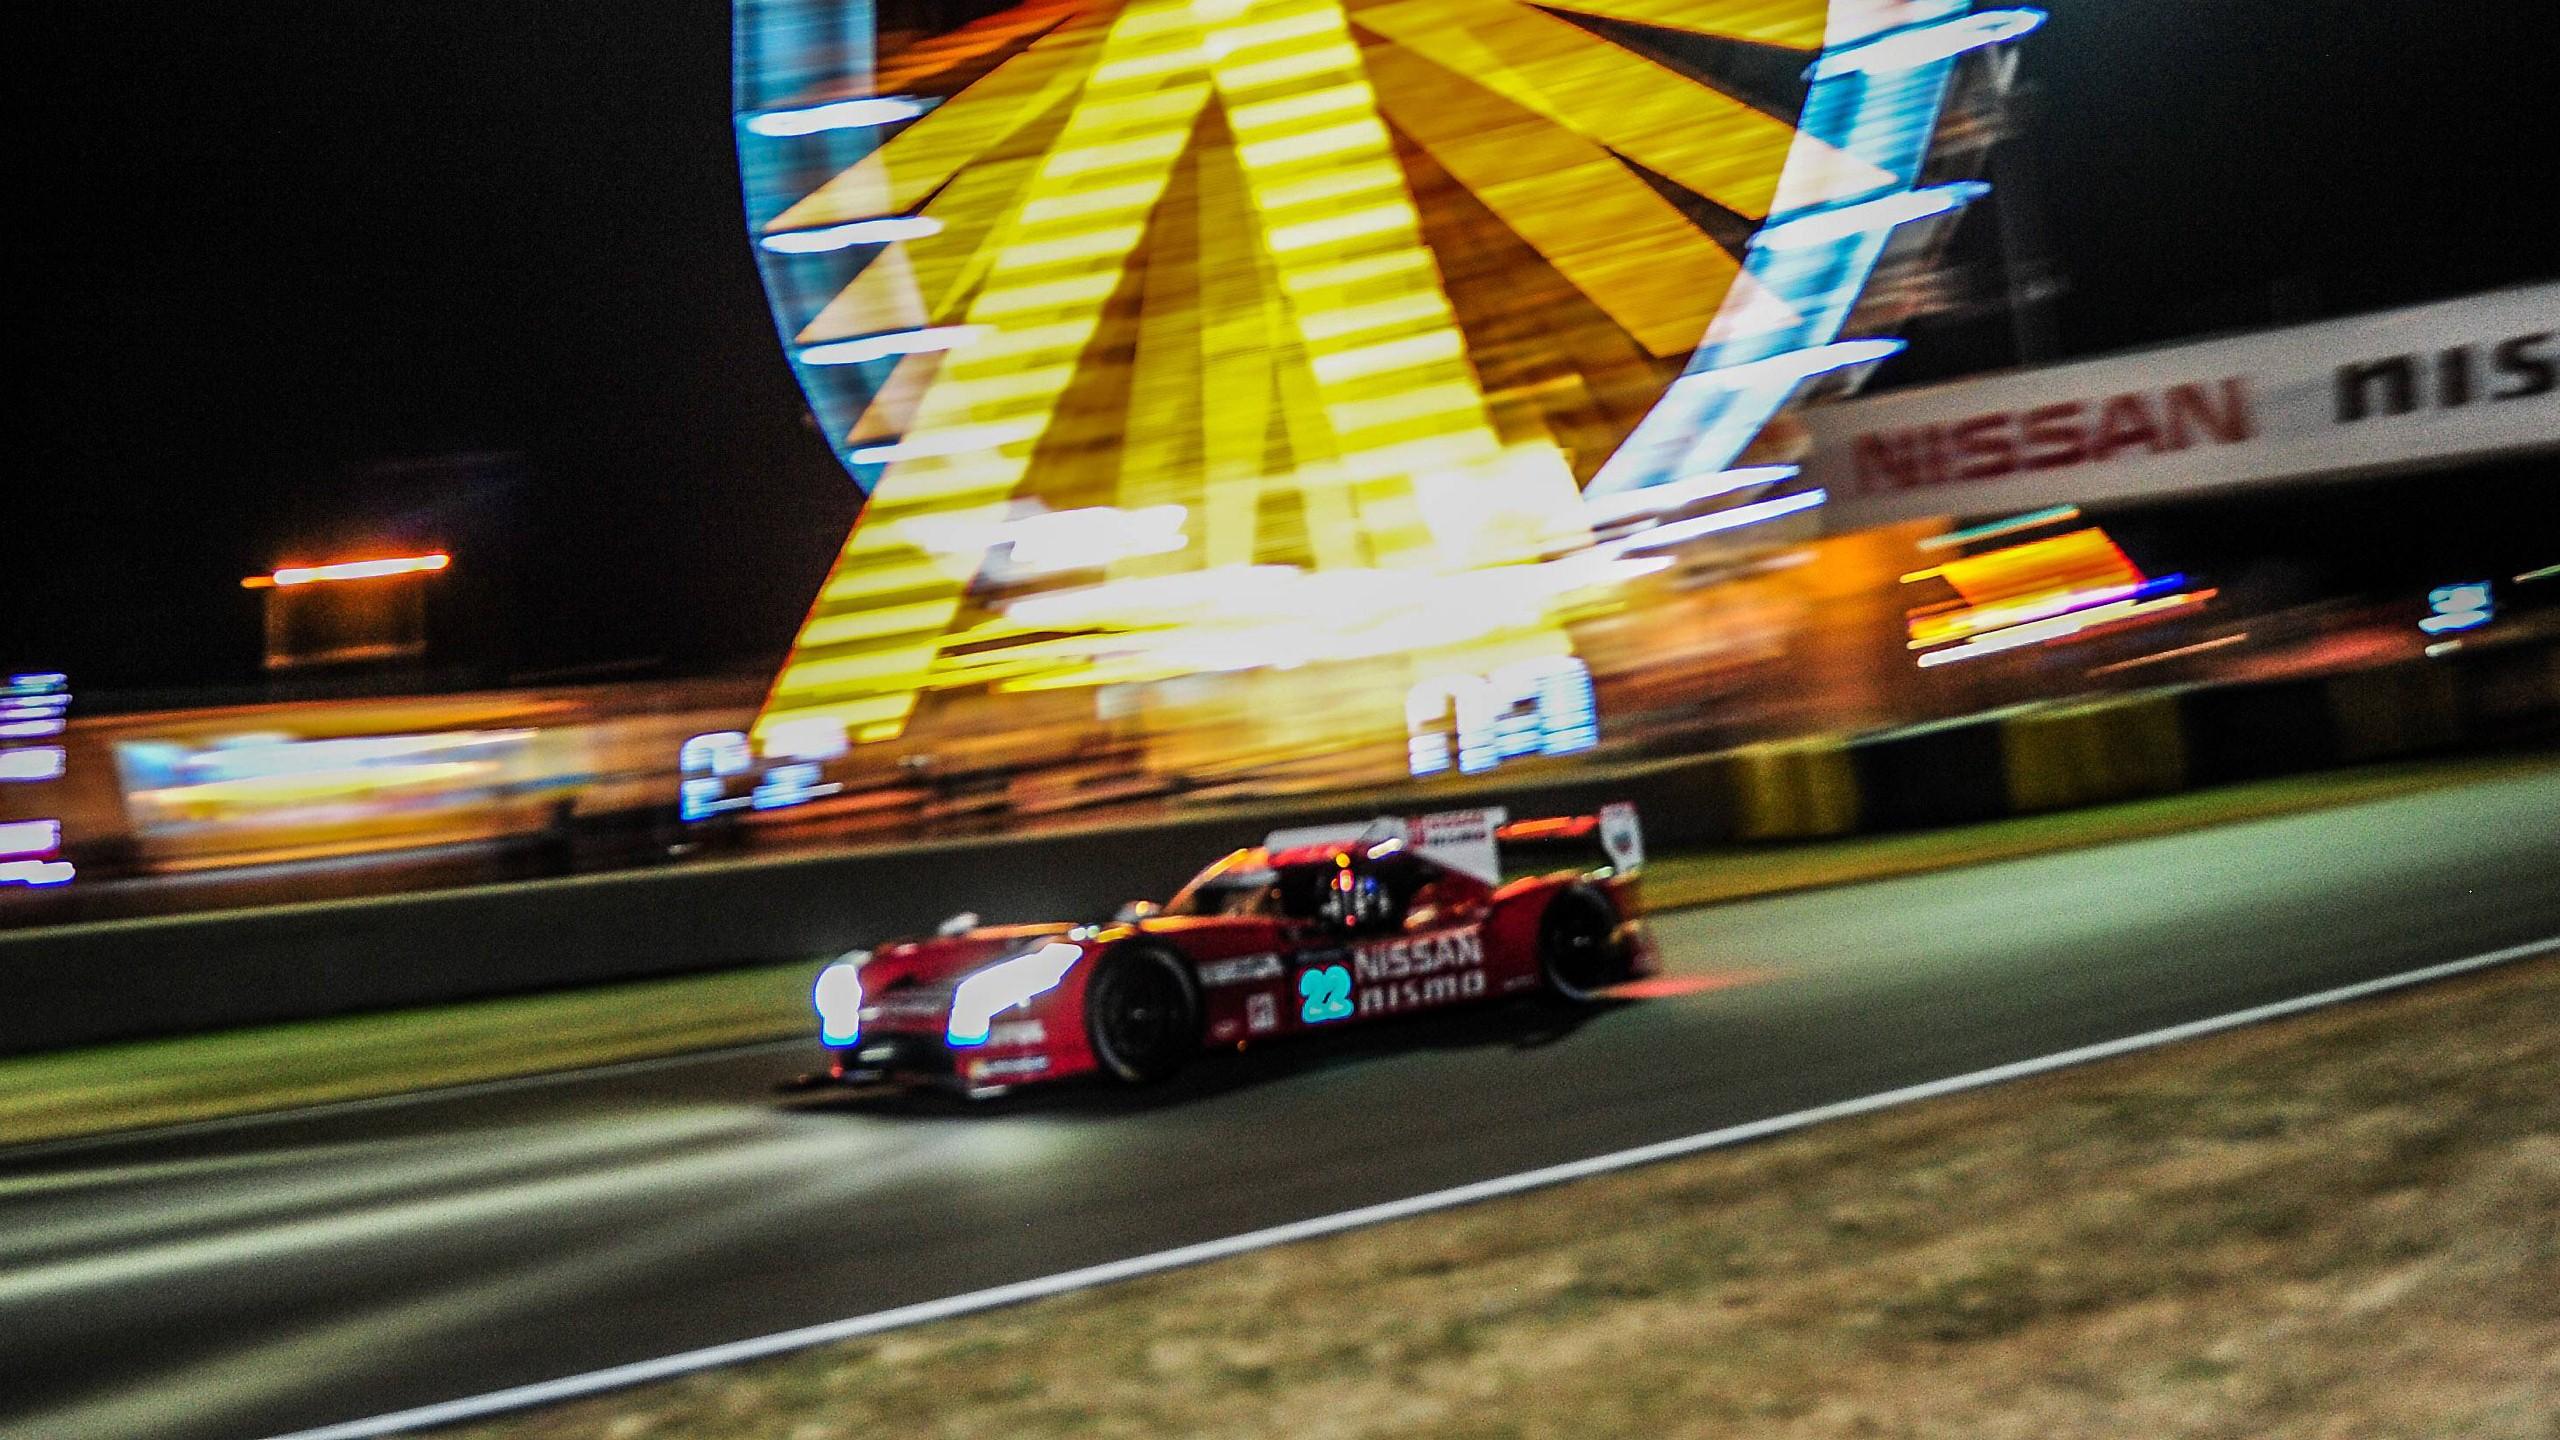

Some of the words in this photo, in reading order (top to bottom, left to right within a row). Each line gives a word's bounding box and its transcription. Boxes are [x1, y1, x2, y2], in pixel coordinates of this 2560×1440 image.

[1853, 376, 2256, 494] NISSAN
[1354, 932, 1484, 982] NISSAN
[1299, 963, 1355, 1024] 22
[1359, 969, 1486, 1018] nismo
